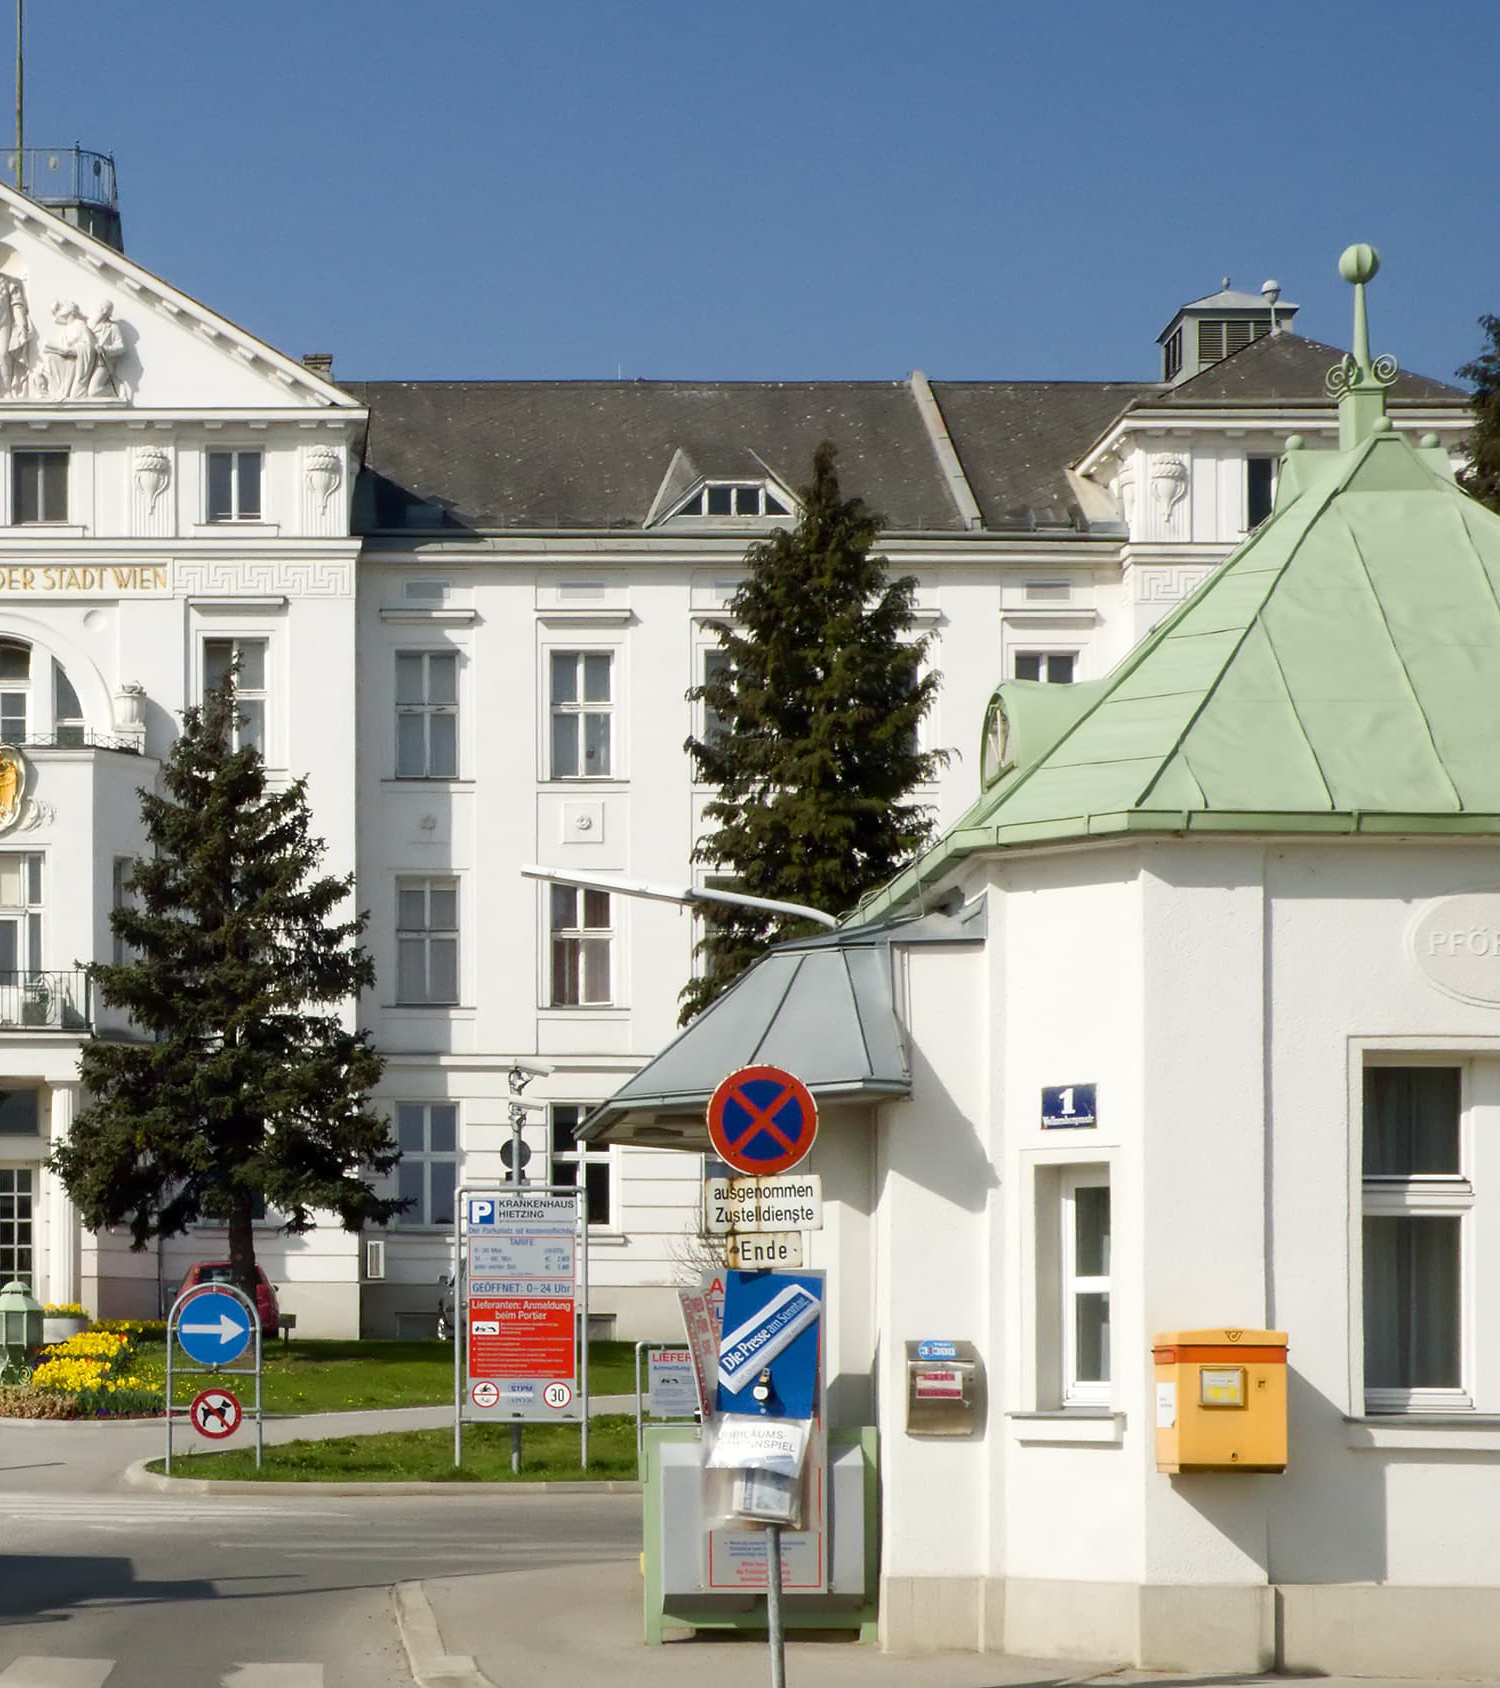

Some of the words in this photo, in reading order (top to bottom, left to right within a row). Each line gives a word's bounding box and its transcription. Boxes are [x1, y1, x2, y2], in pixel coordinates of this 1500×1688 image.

[43, 566, 107, 591] STADT
[108, 566, 168, 591] WIEN
[1059, 1087, 1077, 1115] 1
[714, 1184, 814, 1203] ausgenommen
[472, 1200, 492, 1224] P
[499, 1200, 574, 1208] KRANKENHAUS
[715, 1204, 814, 1223] Zustelldienste
[499, 1210, 545, 1218] HIETZING
[741, 1240, 788, 1261] Ende
[472, 1282, 524, 1294] GEÖFFNET:
[554, 1283, 570, 1294] Uhr
[472, 1300, 521, 1310] Lieferanten:
[524, 1301, 571, 1312] Anmeldung
[495, 1310, 516, 1320] beim
[518, 1310, 547, 1320] Portier
[722, 1351, 745, 1371] Die
[738, 1328, 772, 1358] Presse
[767, 1320, 782, 1334] am
[550, 1388, 564, 1402] 30
